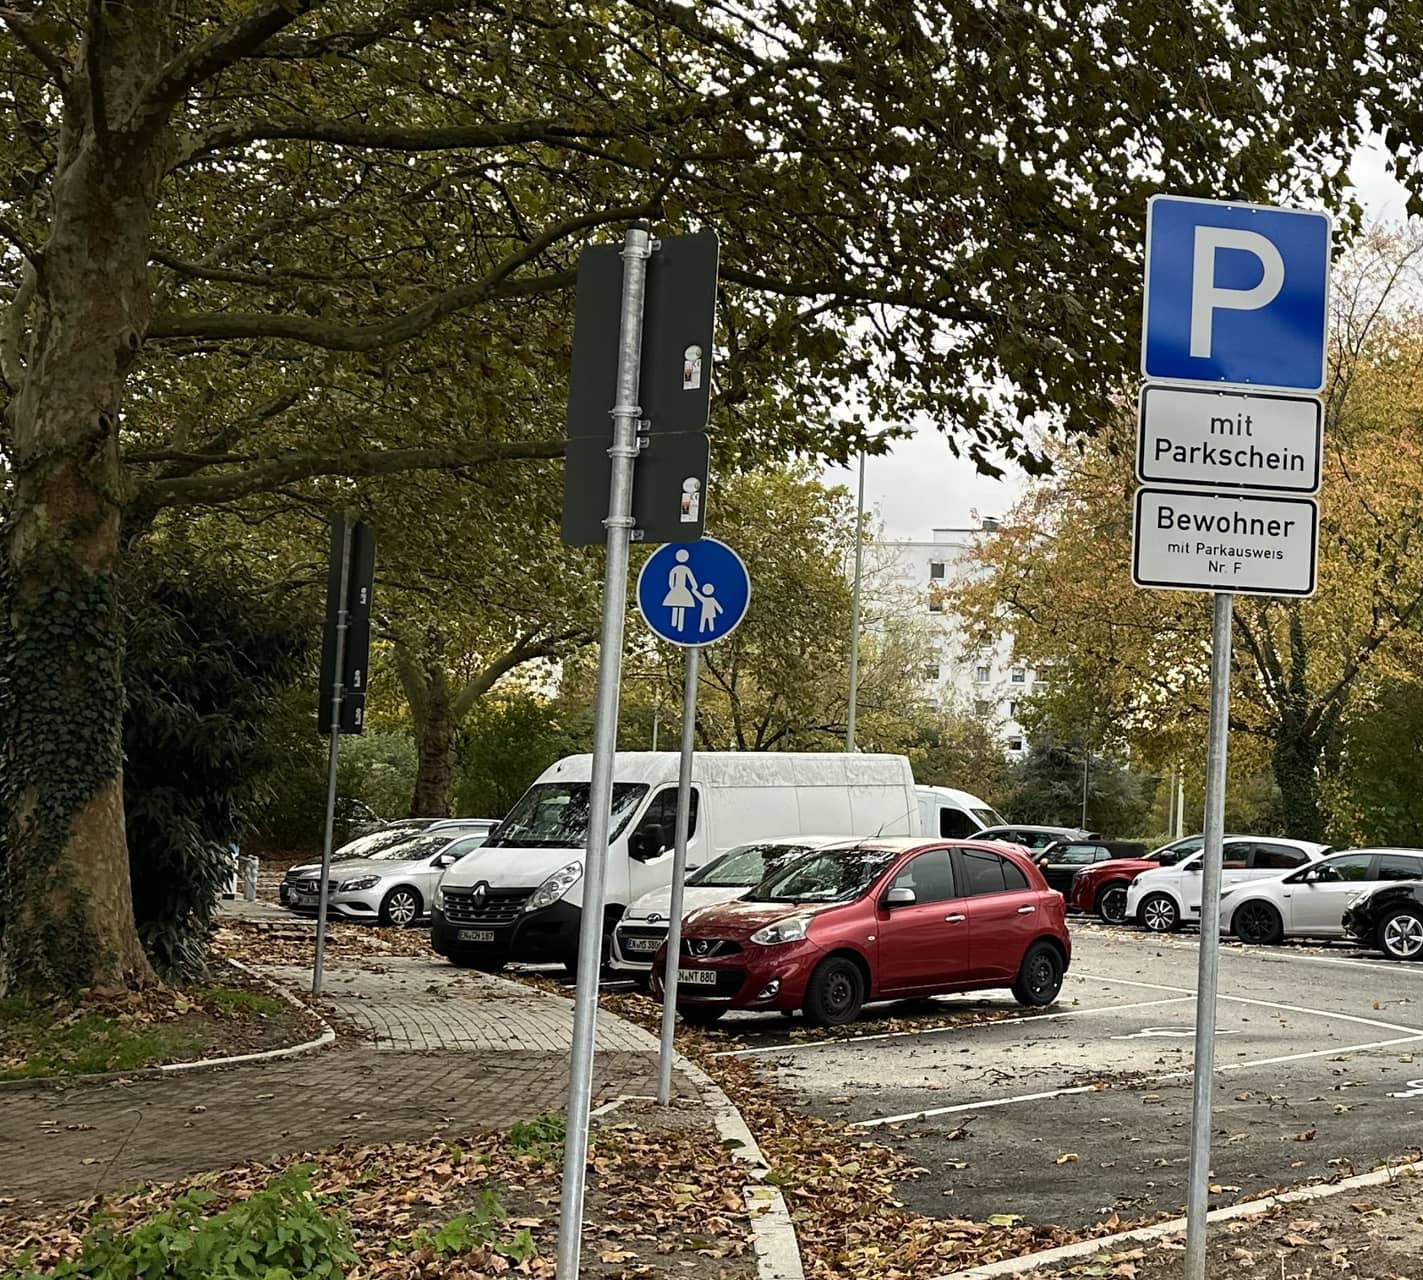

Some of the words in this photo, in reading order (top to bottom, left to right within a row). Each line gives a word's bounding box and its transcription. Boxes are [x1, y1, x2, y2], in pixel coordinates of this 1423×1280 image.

[1190, 225, 1285, 359] P
[1210, 413, 1253, 437] mit
[1155, 438, 1305, 472] Parkschein
[1157, 506, 1296, 537] Bewohner
[1167, 542, 1190, 554] mit
[1196, 542, 1284, 560] Parkausweis
[1233, 562, 1242, 574] F
